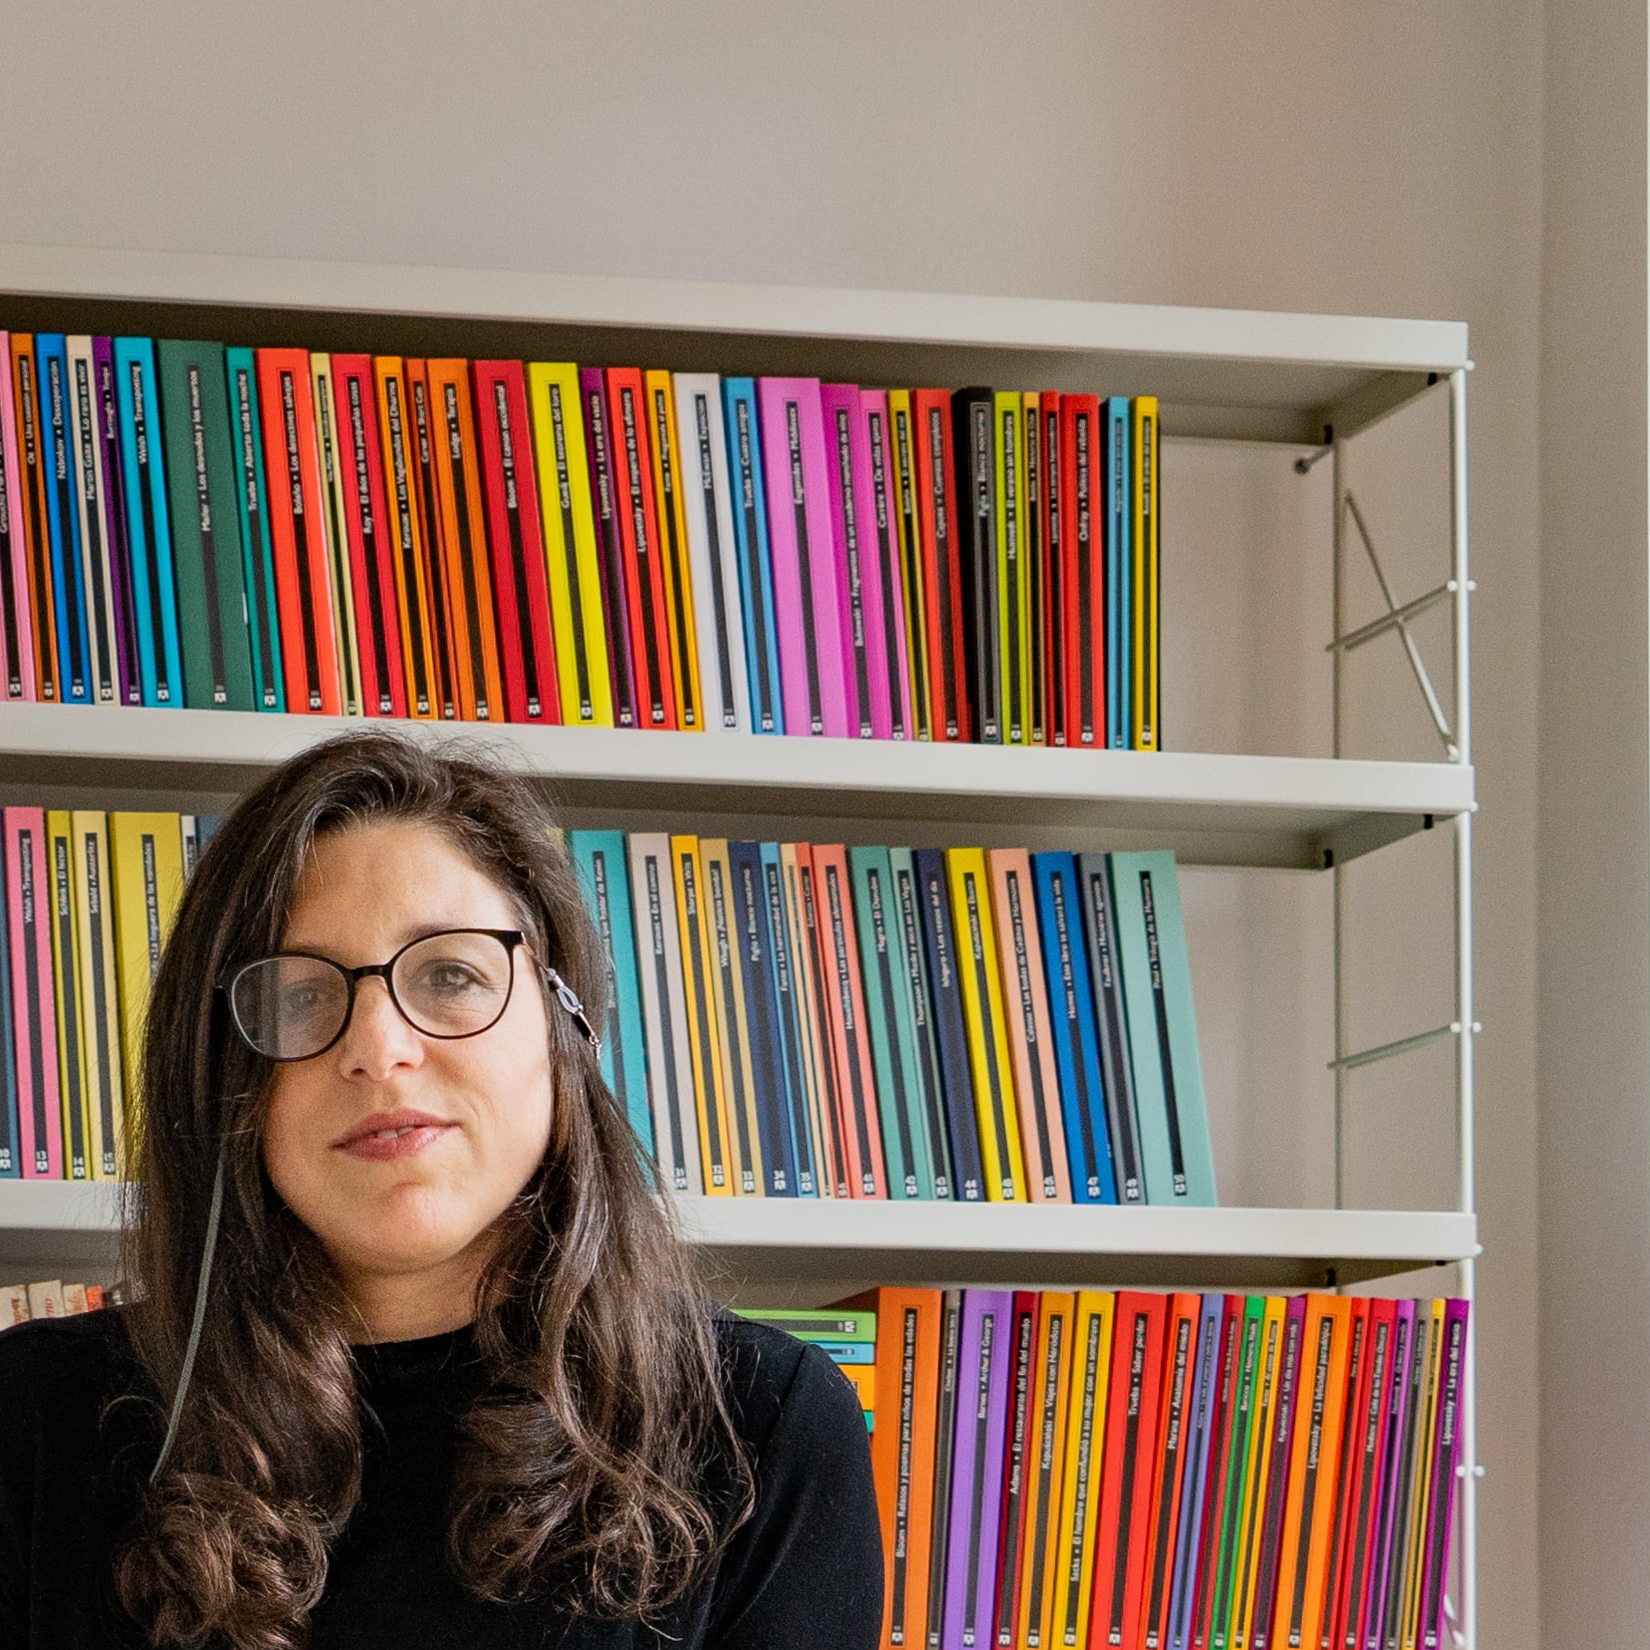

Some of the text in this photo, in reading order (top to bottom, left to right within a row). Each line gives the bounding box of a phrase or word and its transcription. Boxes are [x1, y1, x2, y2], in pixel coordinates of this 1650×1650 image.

[49, 360, 66, 480] Nabokov Desesperación
[131, 365, 147, 464] Welsh Trainspotting
